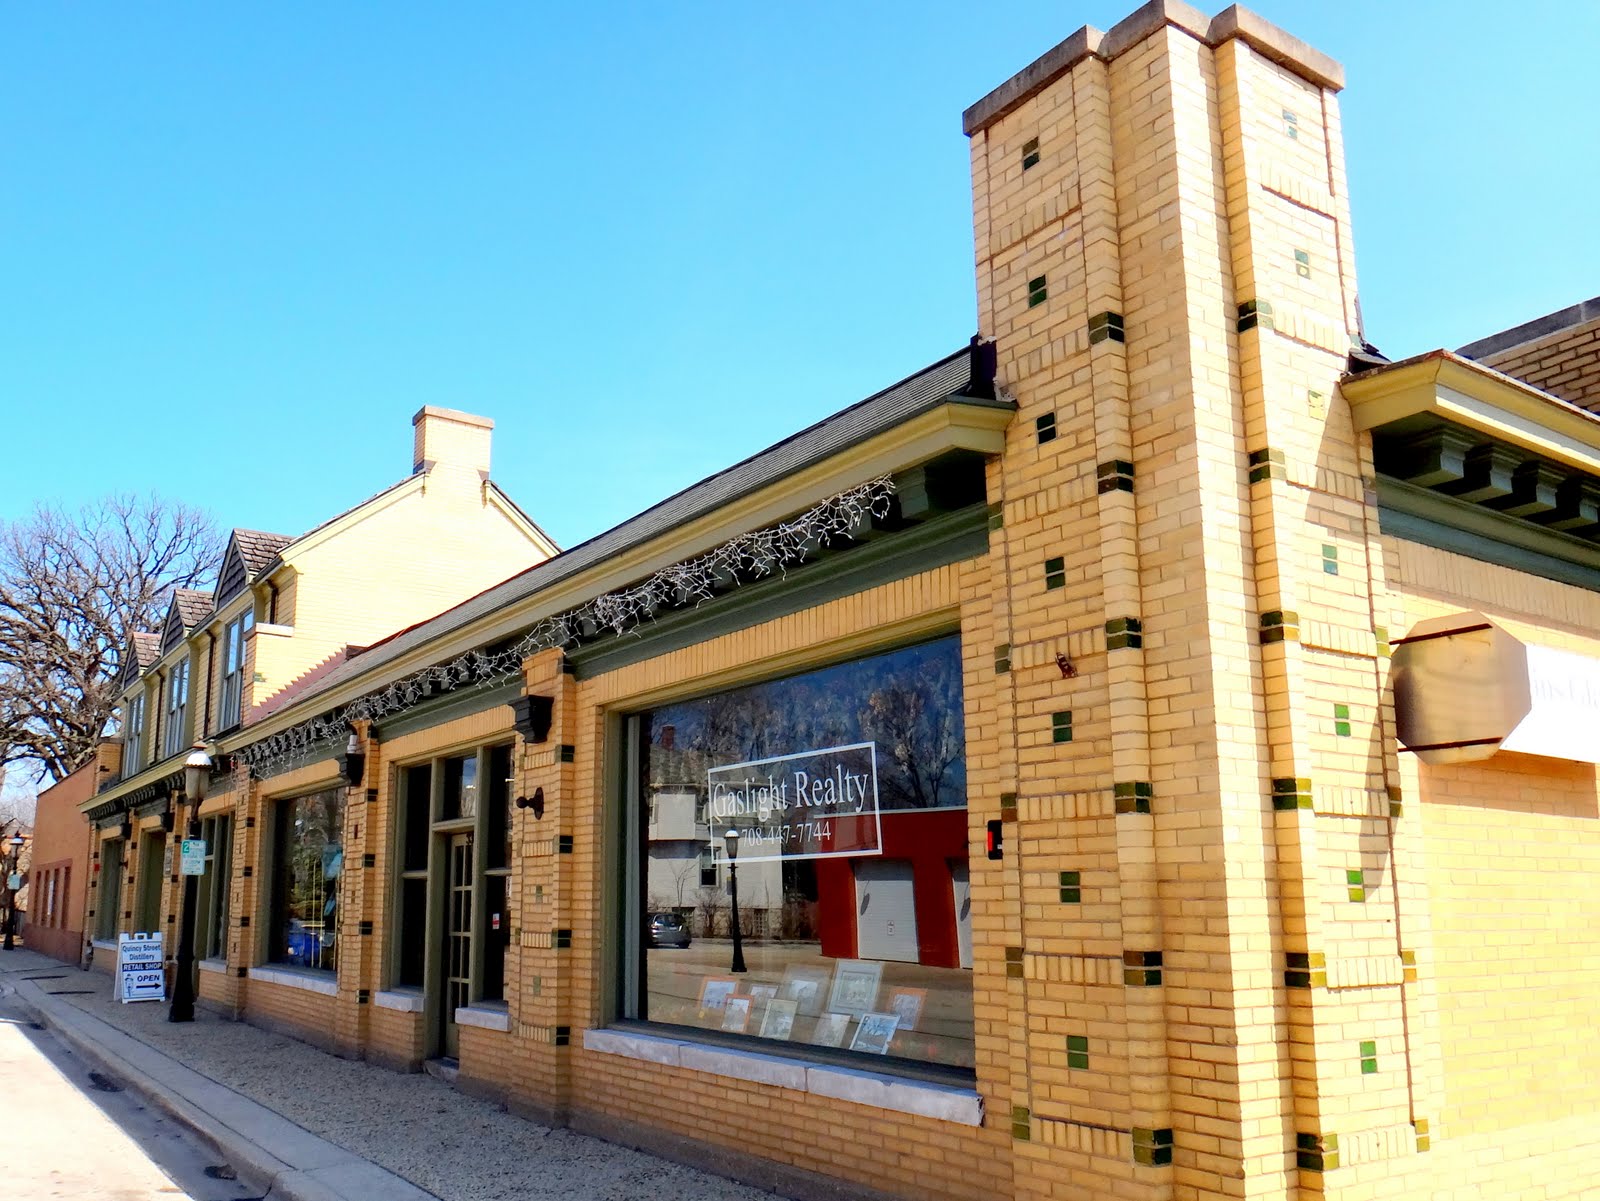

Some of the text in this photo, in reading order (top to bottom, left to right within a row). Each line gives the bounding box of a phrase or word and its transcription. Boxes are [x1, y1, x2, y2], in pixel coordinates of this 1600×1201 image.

[713, 764, 868, 822] Gaslight Realty
[741, 821, 831, 848] 708-447-7744
[122, 944, 161, 953] Quincy Street
[129, 953, 155, 961] Distillery
[123, 962, 162, 971] RETAIL SHOP
[137, 974, 160, 982] OPEN
